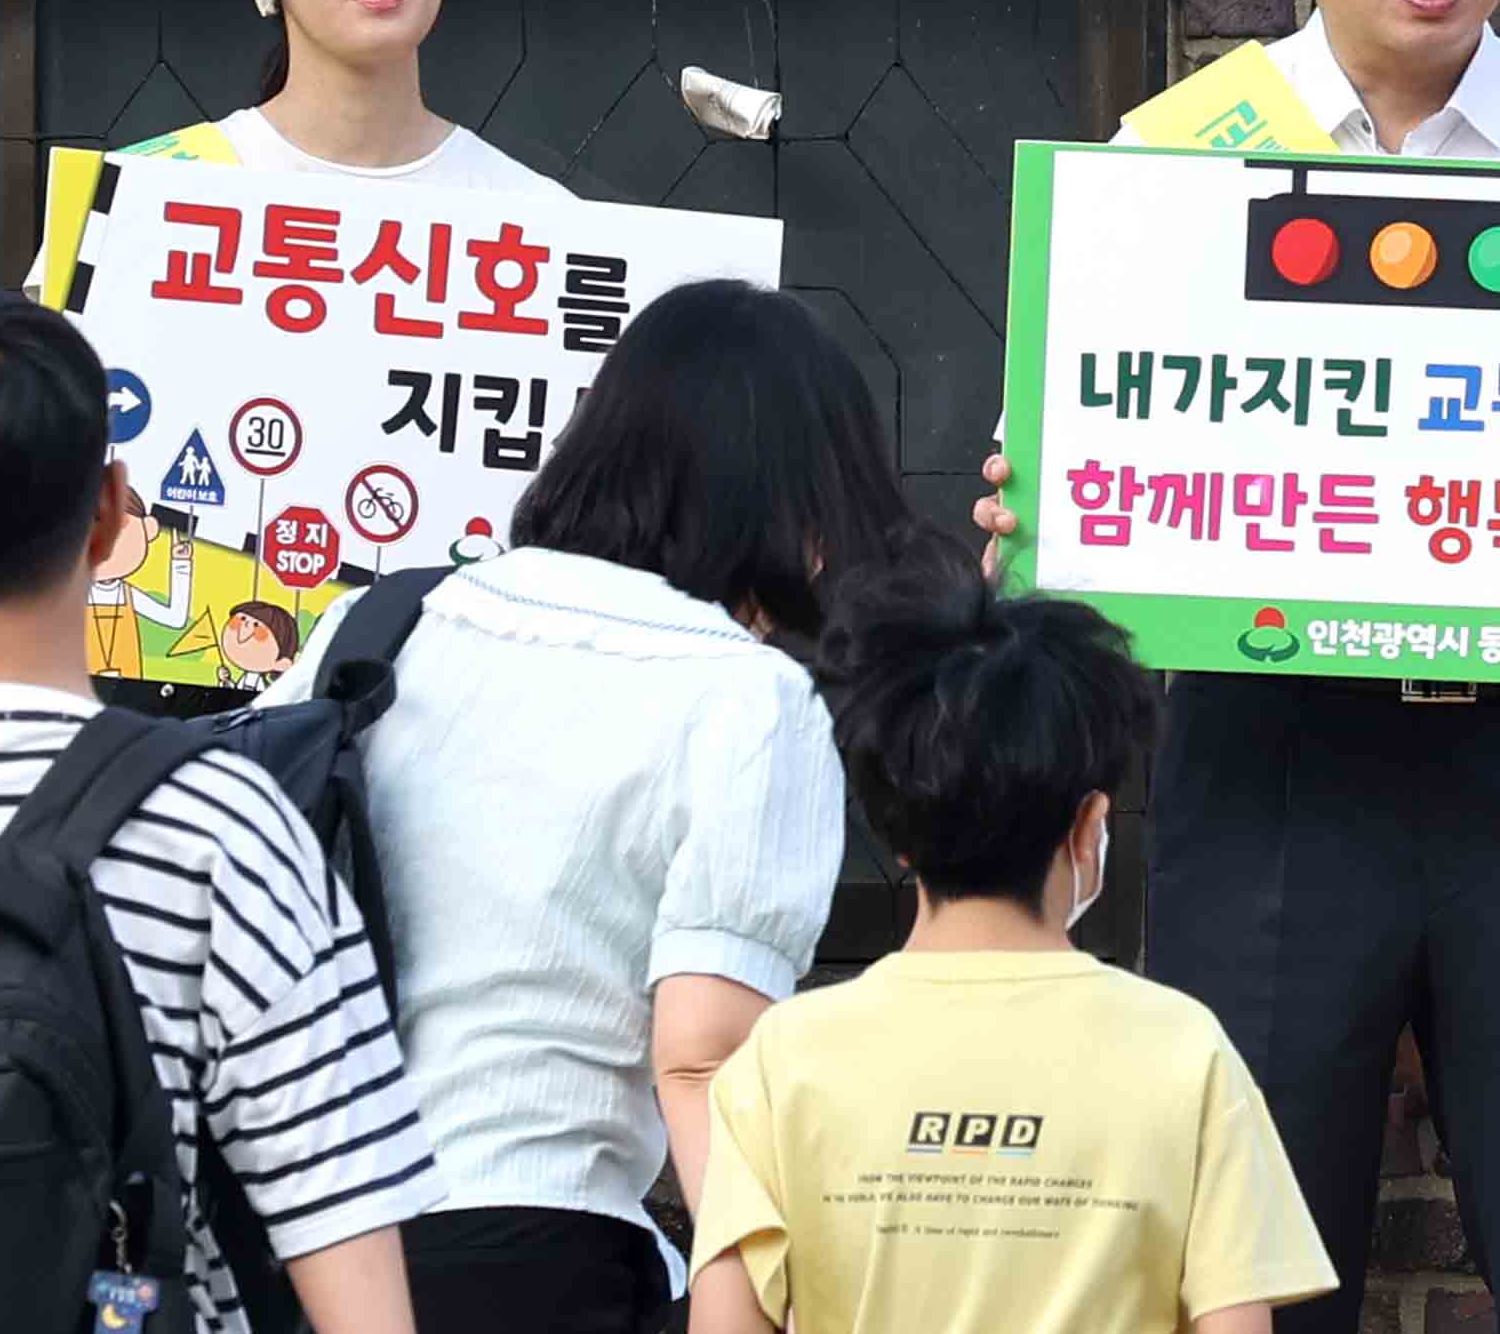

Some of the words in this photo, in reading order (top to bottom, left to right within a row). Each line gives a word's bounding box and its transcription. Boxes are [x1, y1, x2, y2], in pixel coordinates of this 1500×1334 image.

[151, 200, 631, 354] 교통신호를
[381, 368, 592, 473] 지킵
[1079, 350, 1393, 438] 내가지킨
[247, 416, 286, 451] 30
[1065, 458, 1380, 556] 함께만든
[275, 550, 327, 576] STOP
[1306, 618, 1470, 660] 인천광역시
[912, 1114, 1041, 1146] RPD
